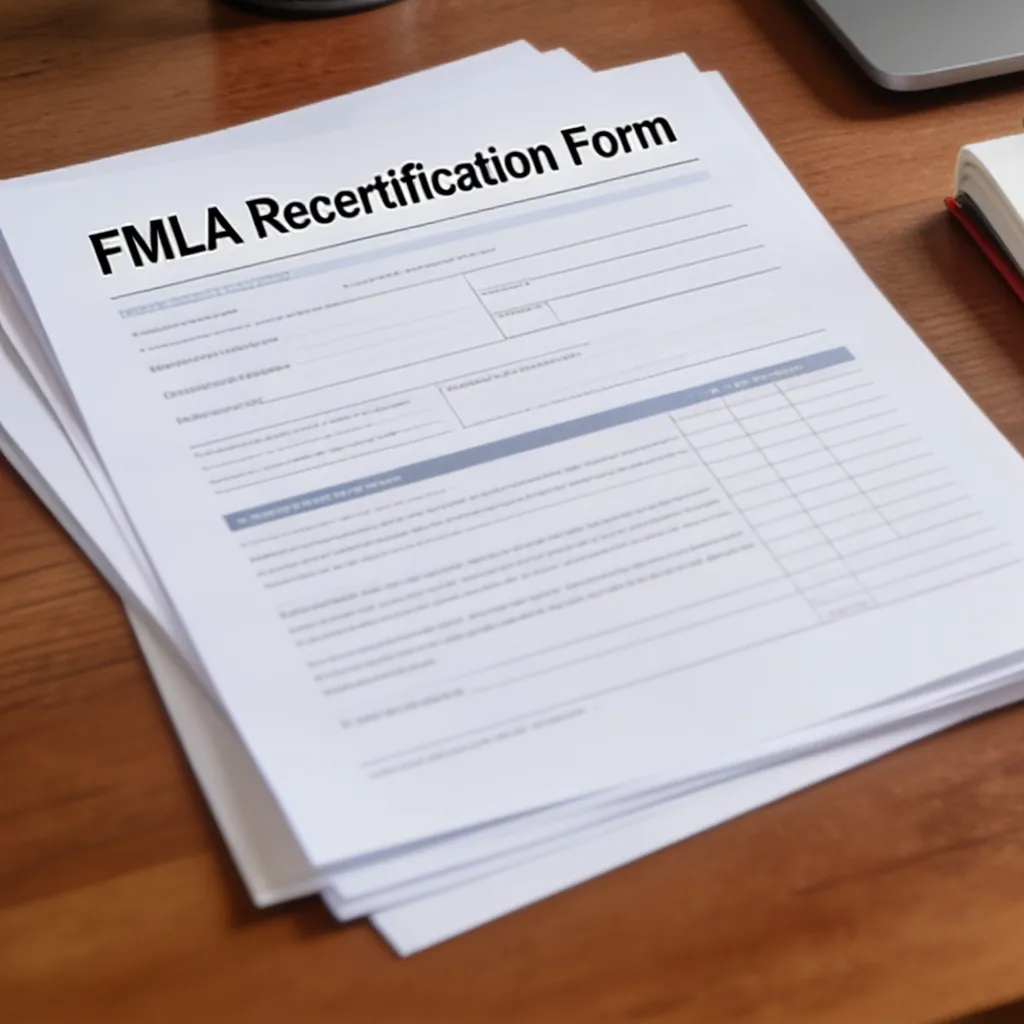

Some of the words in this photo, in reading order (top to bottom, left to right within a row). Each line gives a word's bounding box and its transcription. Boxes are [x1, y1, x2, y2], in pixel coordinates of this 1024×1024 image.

[89, 206, 244, 275] FMLA
[245, 144, 559, 238] Recertification
[560, 116, 678, 166] Form
